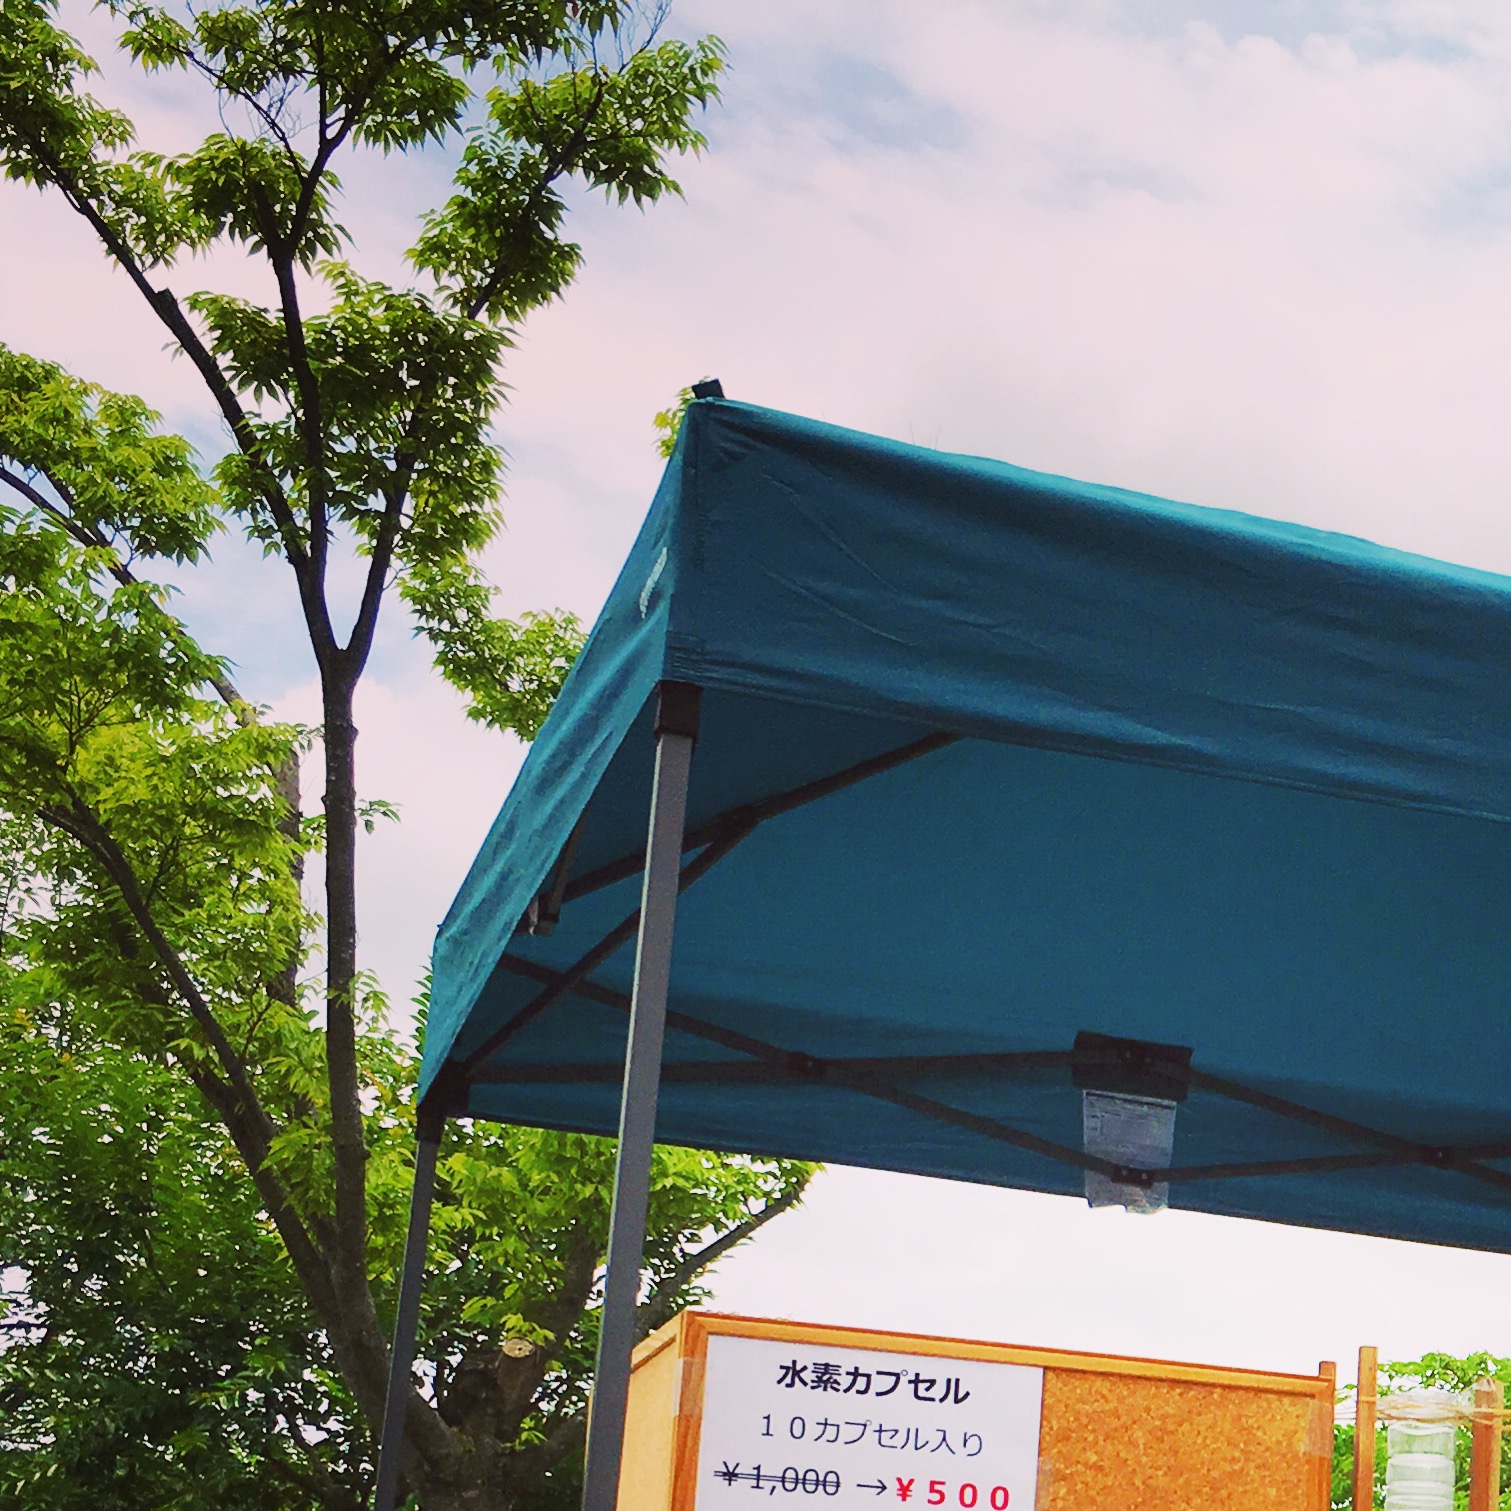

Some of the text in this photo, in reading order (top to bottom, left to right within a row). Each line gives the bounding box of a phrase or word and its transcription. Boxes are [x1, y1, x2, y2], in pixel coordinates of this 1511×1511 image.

[776, 1359, 971, 1405] 水素カプセル
